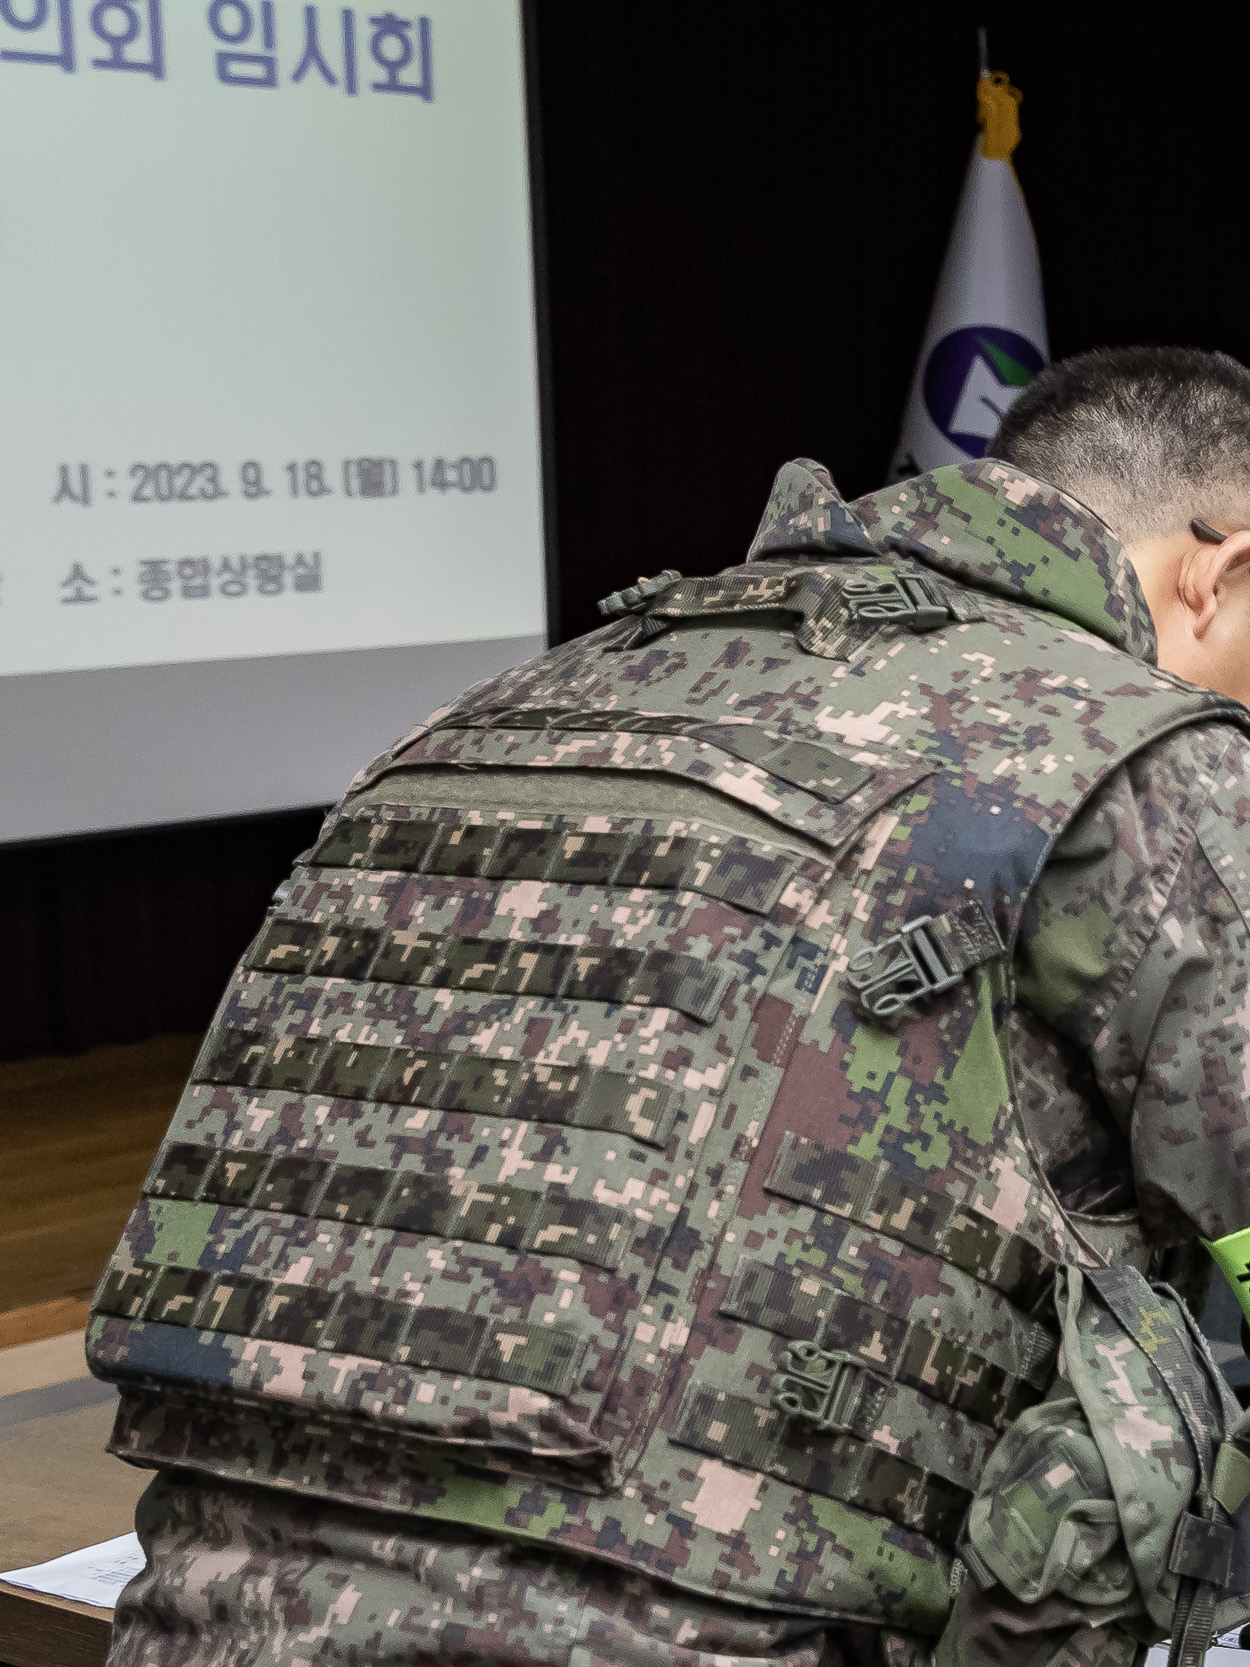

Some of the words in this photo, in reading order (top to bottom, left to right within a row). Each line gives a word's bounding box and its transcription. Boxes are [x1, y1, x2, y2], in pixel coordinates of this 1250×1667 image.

[207, 0, 433, 102] 임시회
[128, 461, 230, 503] 2023.
[240, 460, 271, 499] 9.
[284, 459, 334, 497] 18.
[411, 455, 498, 494] 14:00
[136, 549, 324, 603] 종합상황실
